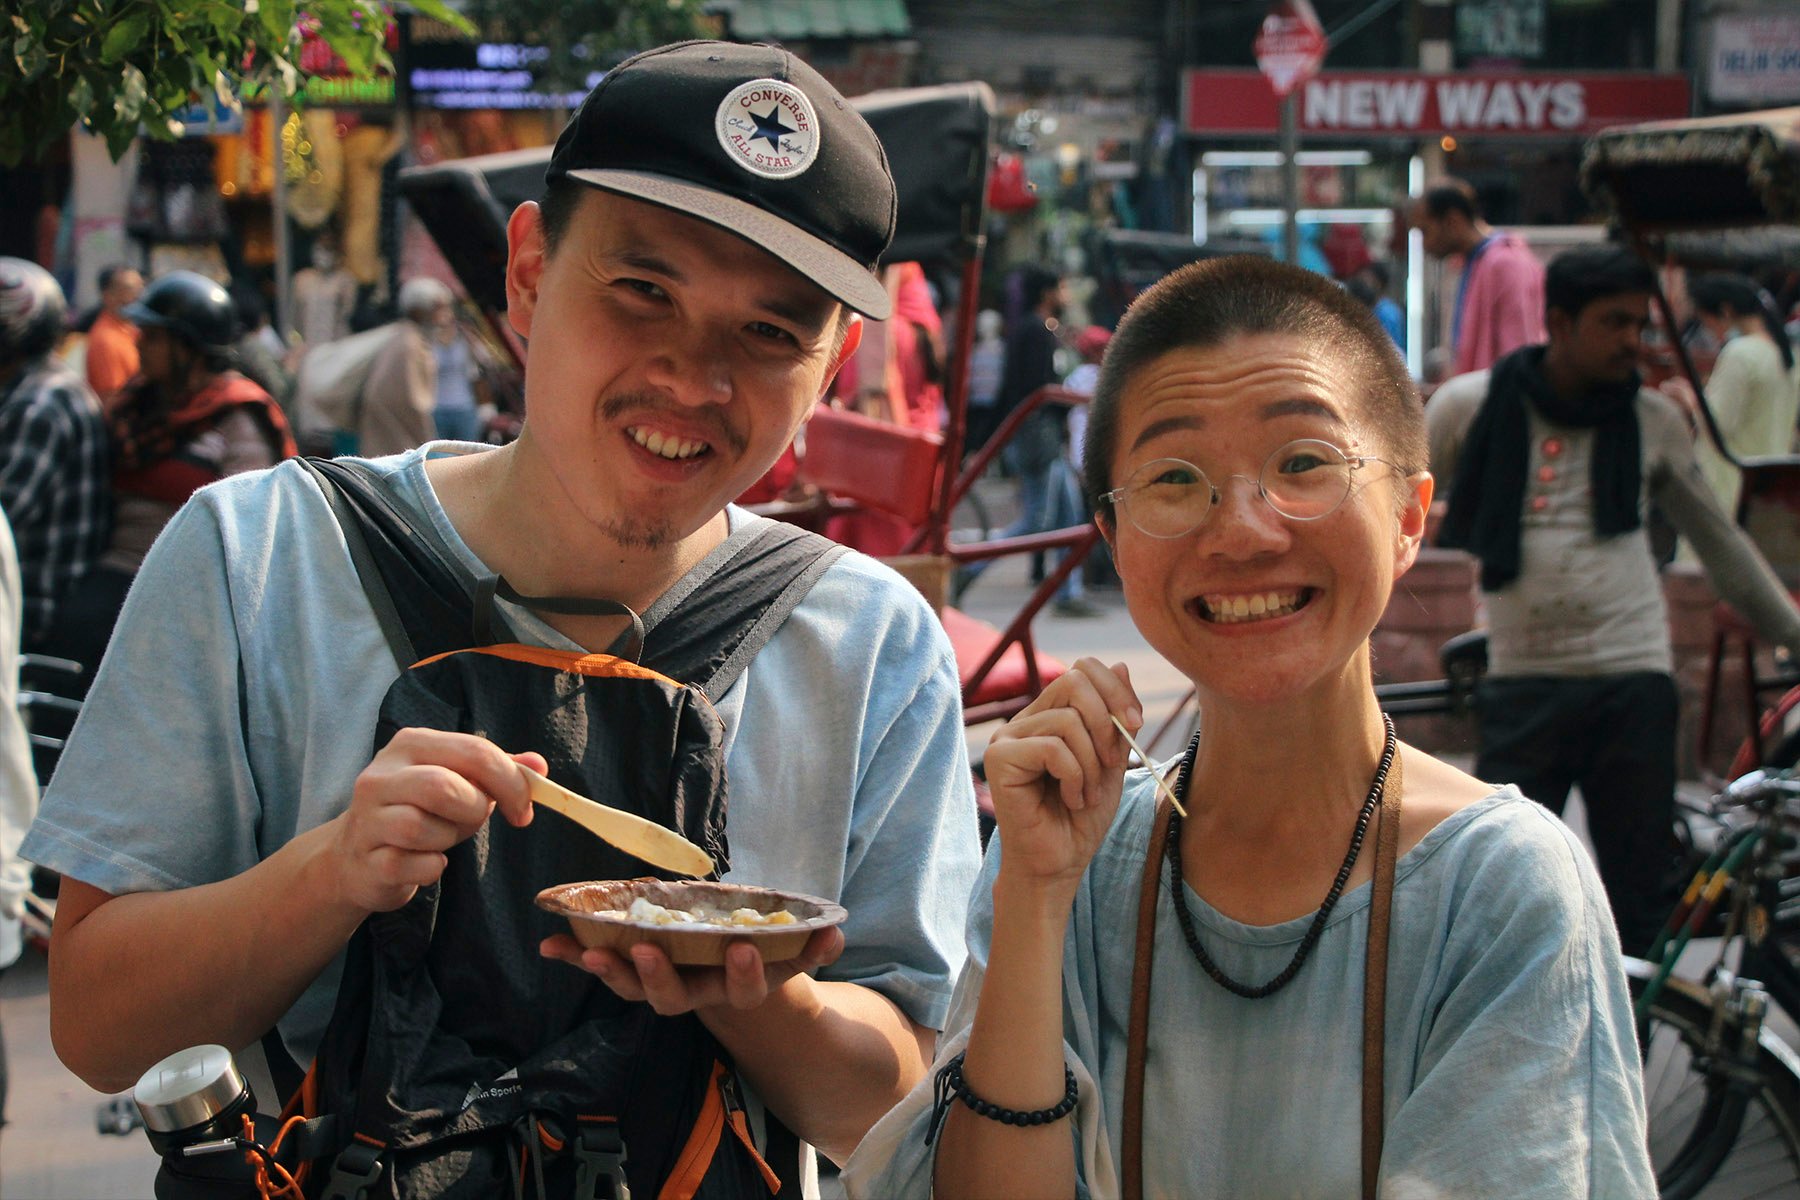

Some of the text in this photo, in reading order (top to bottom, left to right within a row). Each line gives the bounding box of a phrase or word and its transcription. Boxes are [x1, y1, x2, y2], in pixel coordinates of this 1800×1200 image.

[740, 90, 809, 132] CONVERSE
[1304, 79, 1588, 130] NEW WAYS
[731, 134, 792, 167] ALL STAR
